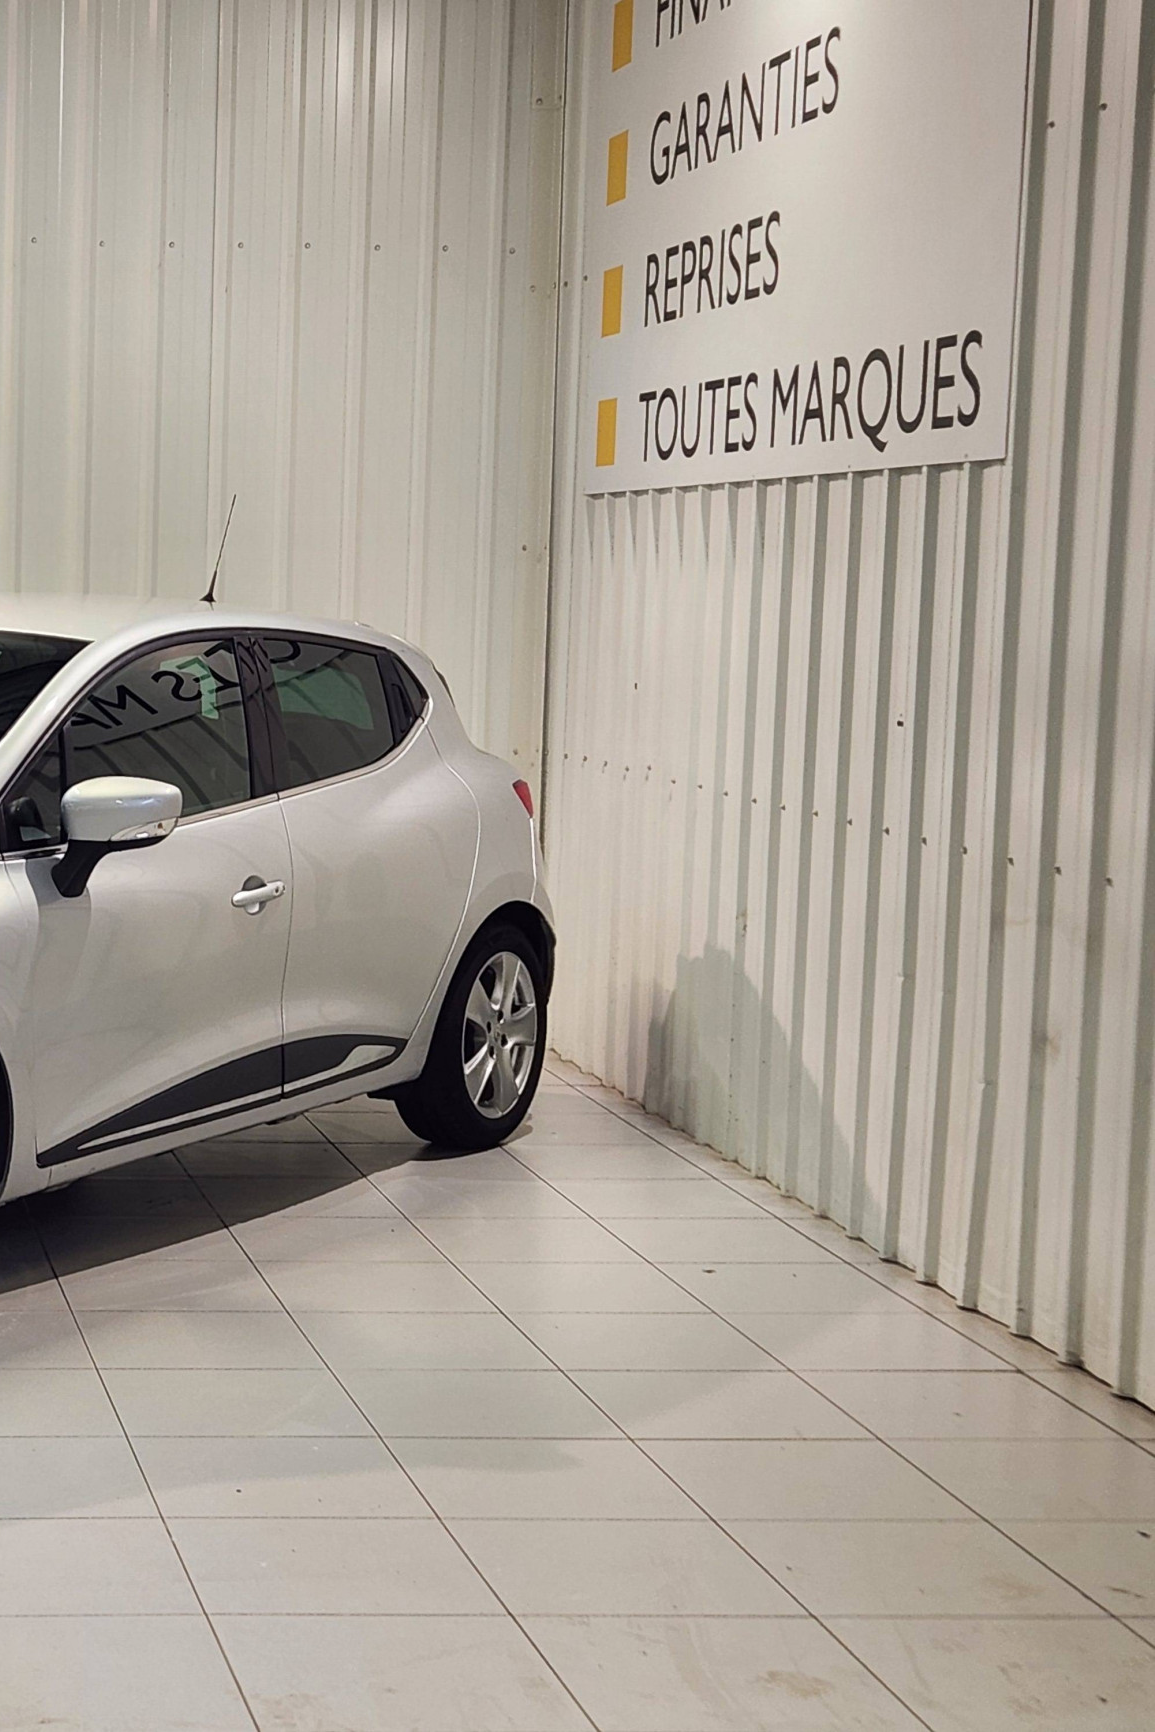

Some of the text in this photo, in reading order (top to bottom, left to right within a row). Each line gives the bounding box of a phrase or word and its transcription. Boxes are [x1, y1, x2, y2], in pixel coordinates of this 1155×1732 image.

[650, 27, 841, 185] GARANTIES
[645, 211, 781, 327] REPRISES
[639, 330, 983, 463] TOUTES MARQUES
